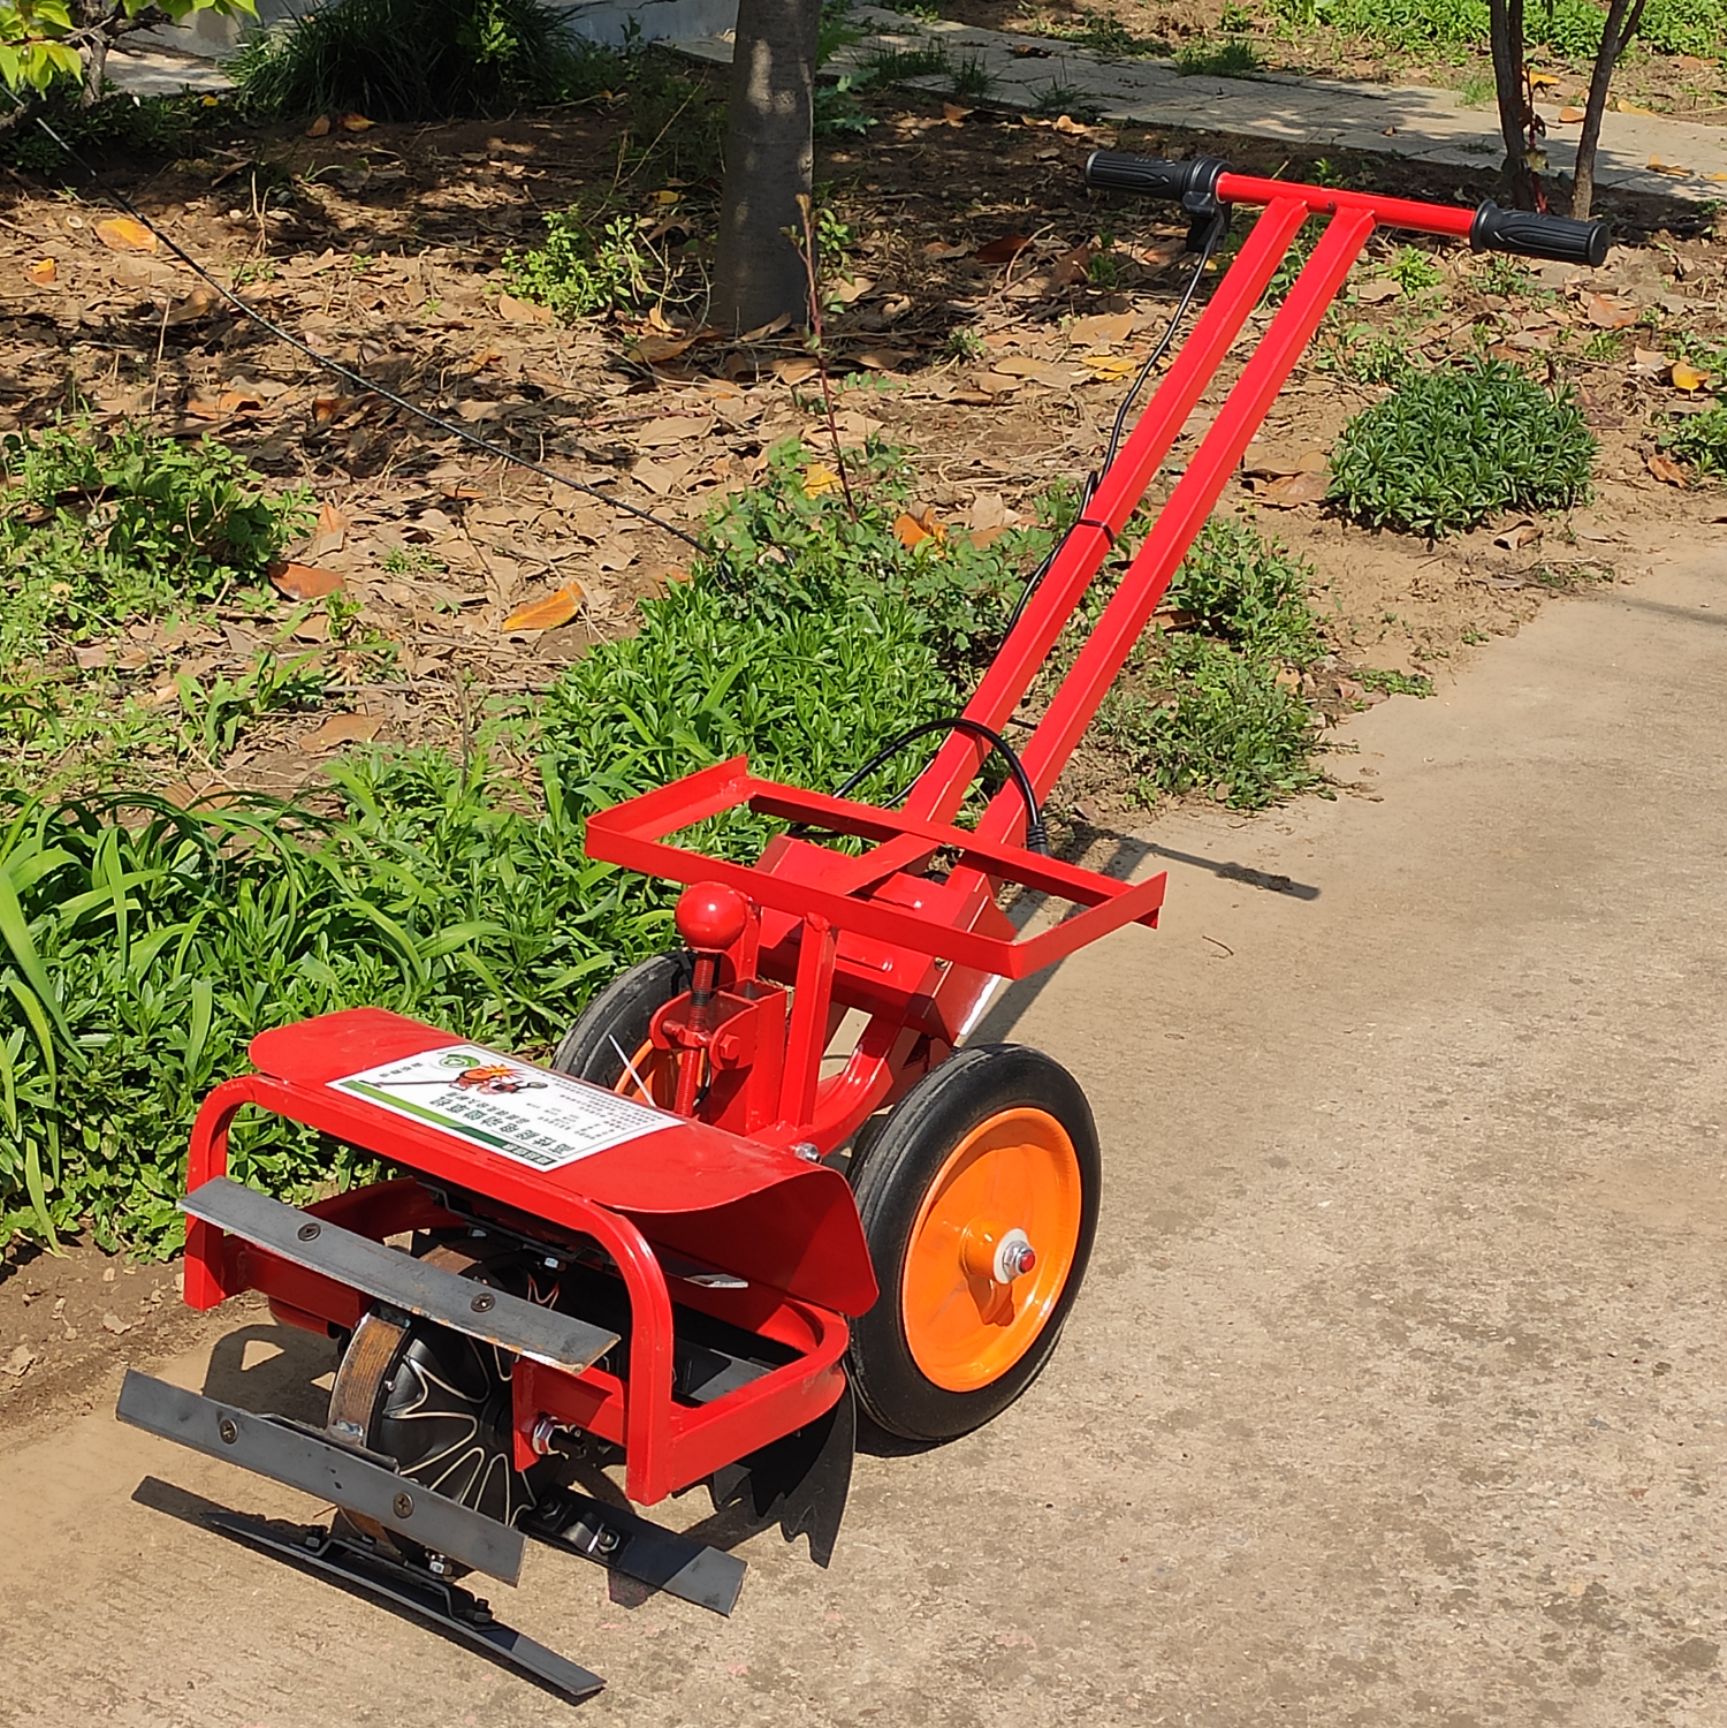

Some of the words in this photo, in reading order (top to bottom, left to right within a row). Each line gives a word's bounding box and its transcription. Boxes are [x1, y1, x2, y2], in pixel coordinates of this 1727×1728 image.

[430, 1095, 576, 1154] 高性能电动锄草机
